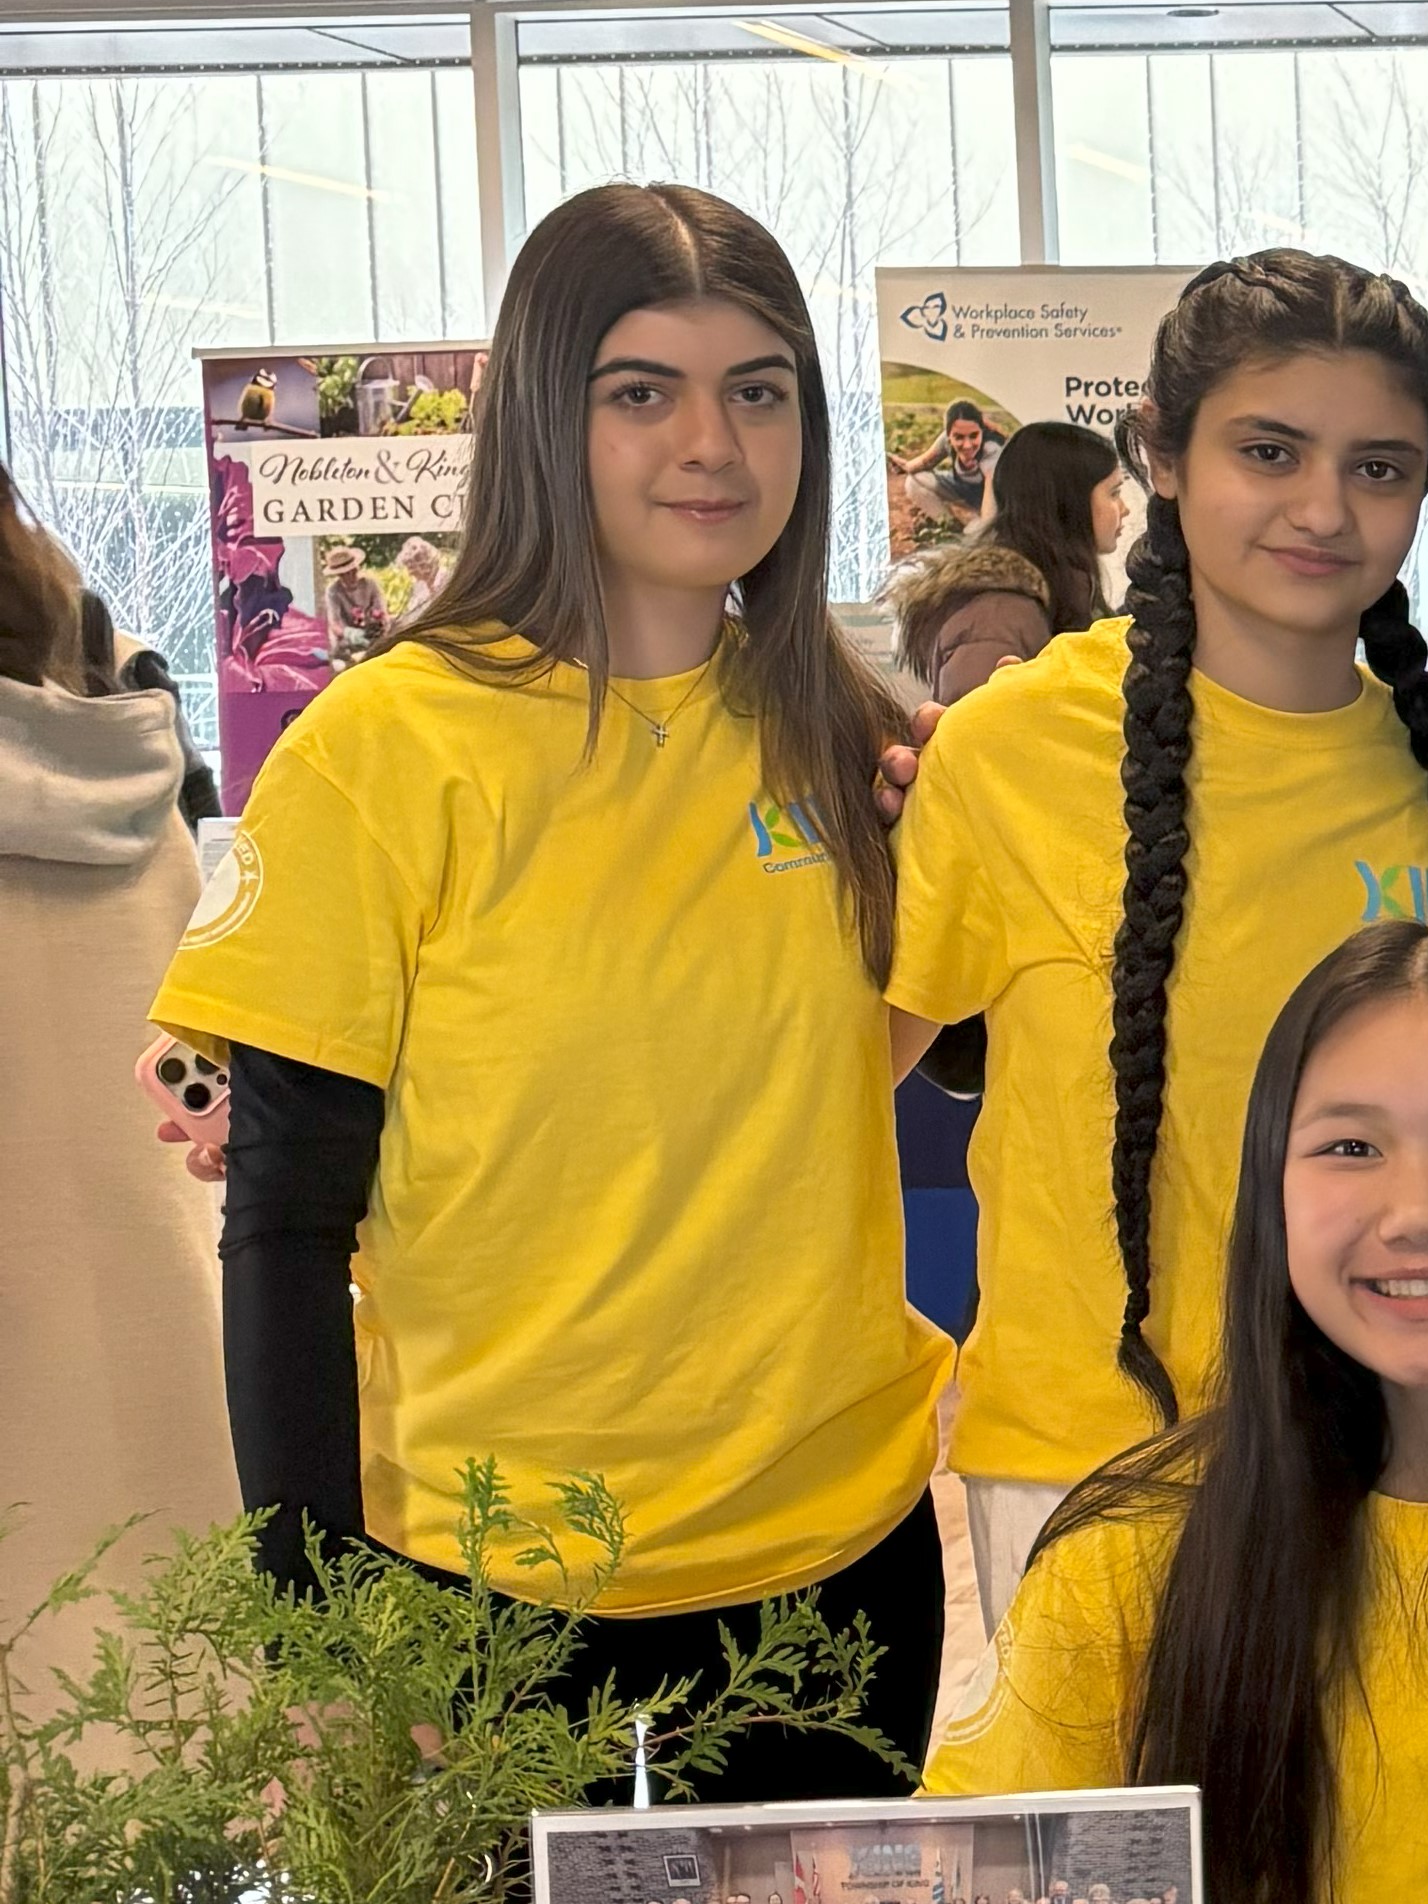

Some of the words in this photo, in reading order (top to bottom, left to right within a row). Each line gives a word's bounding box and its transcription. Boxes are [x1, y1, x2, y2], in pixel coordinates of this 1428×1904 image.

[952, 303, 1035, 323] Workplace
[1040, 302, 1088, 322] Safety
[953, 325, 966, 339] &
[971, 323, 1049, 339] Prevention
[258, 453, 372, 487] Nobleton
[374, 449, 405, 485] &
[263, 495, 415, 524] GARDEN
